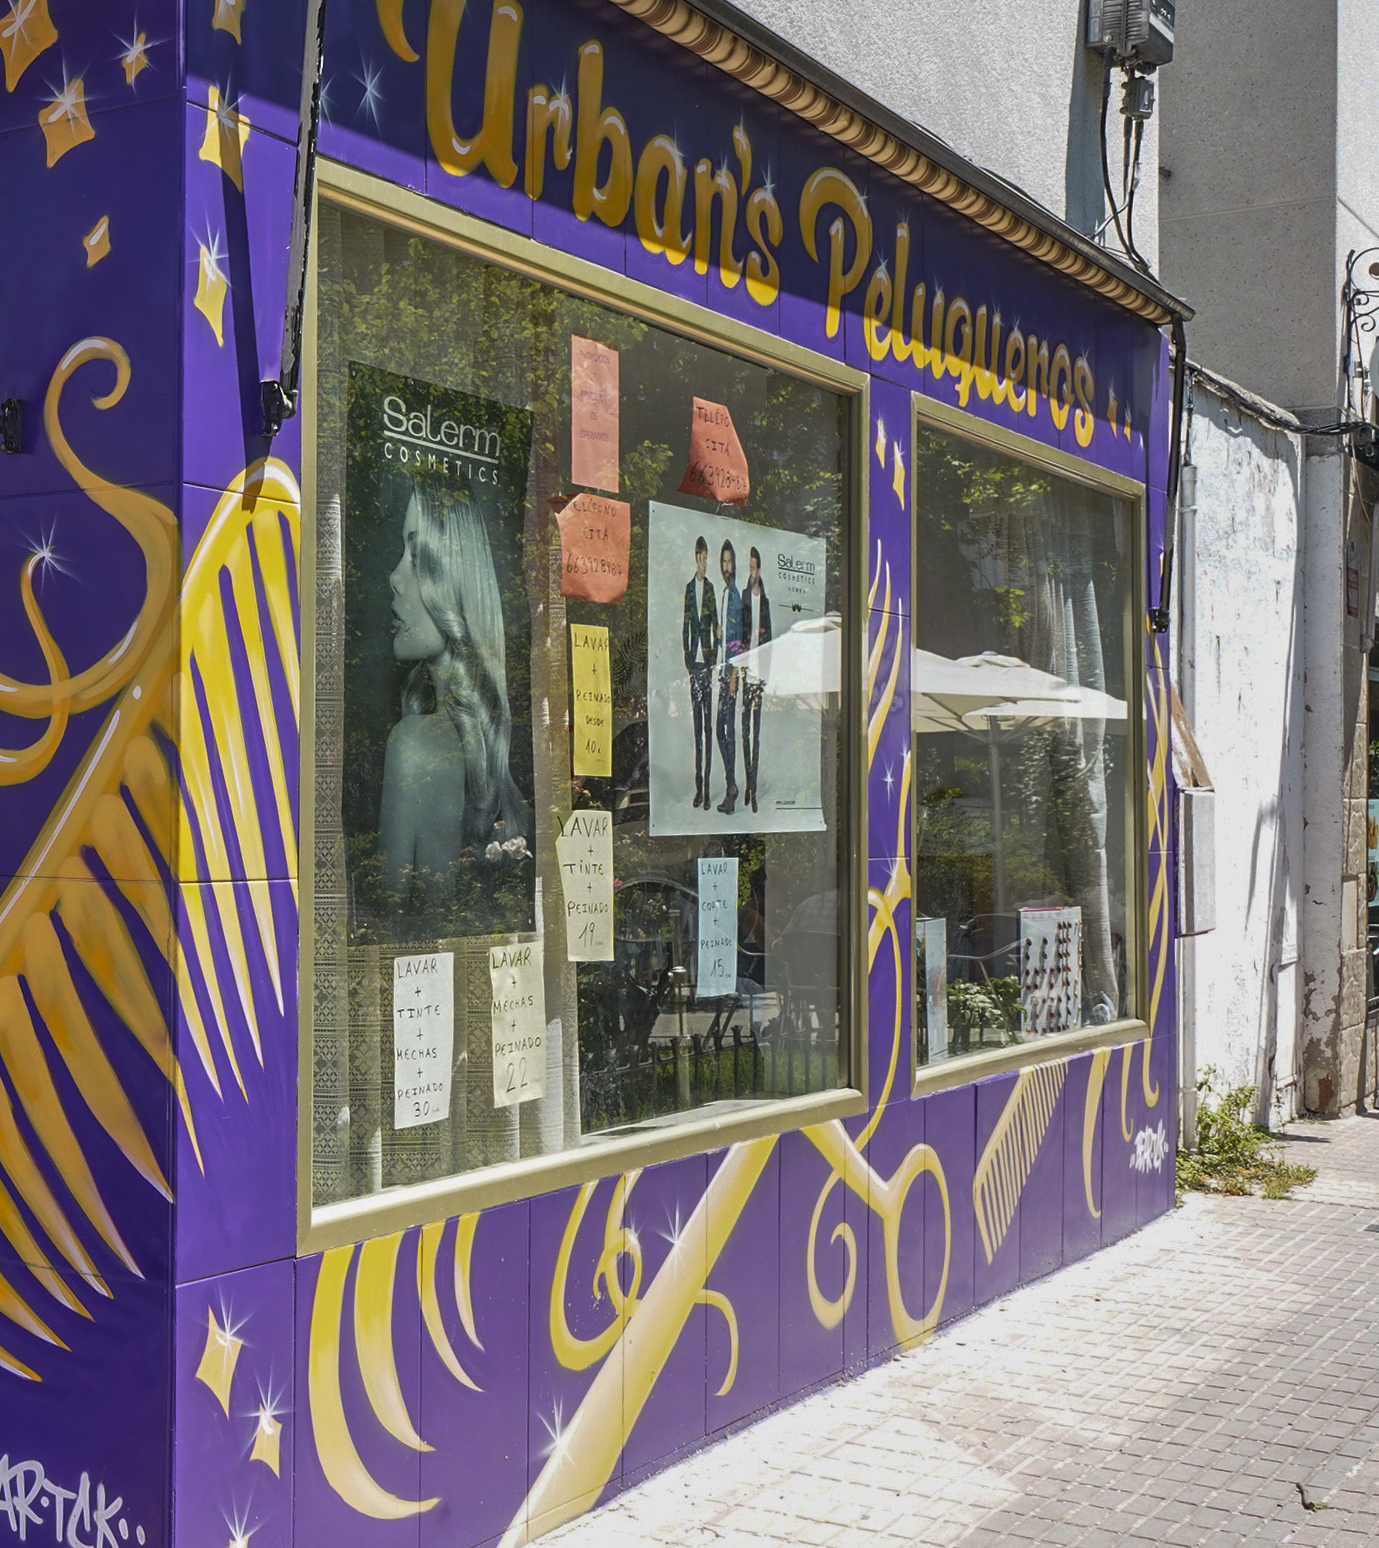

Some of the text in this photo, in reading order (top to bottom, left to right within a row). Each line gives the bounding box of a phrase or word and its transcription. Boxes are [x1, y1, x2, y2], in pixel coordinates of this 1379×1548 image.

[377, 0, 1094, 447] Urban's Peluqueros
[384, 396, 501, 456] Salerm
[706, 438, 730, 456] CITA
[384, 443, 499, 485] COSMETICS
[583, 527, 608, 540] CITA
[778, 553, 815, 571] Salerm
[586, 715, 604, 726] DESDE
[557, 816, 609, 837] LAVAR
[567, 901, 608, 916] PEINADO
[579, 922, 595, 947] 19
[492, 947, 532, 970] LAVAR
[710, 958, 725, 978] 15
[396, 958, 438, 979] LAVAR
[397, 1004, 440, 1019] TINTE
[493, 995, 534, 1014] MECHAS
[396, 1047, 437, 1061] MECHAS
[495, 1036, 542, 1058] PEINADO
[506, 1057, 528, 1093] 22
[397, 1083, 443, 1100] PEINADO
[413, 1101, 430, 1118] 30
